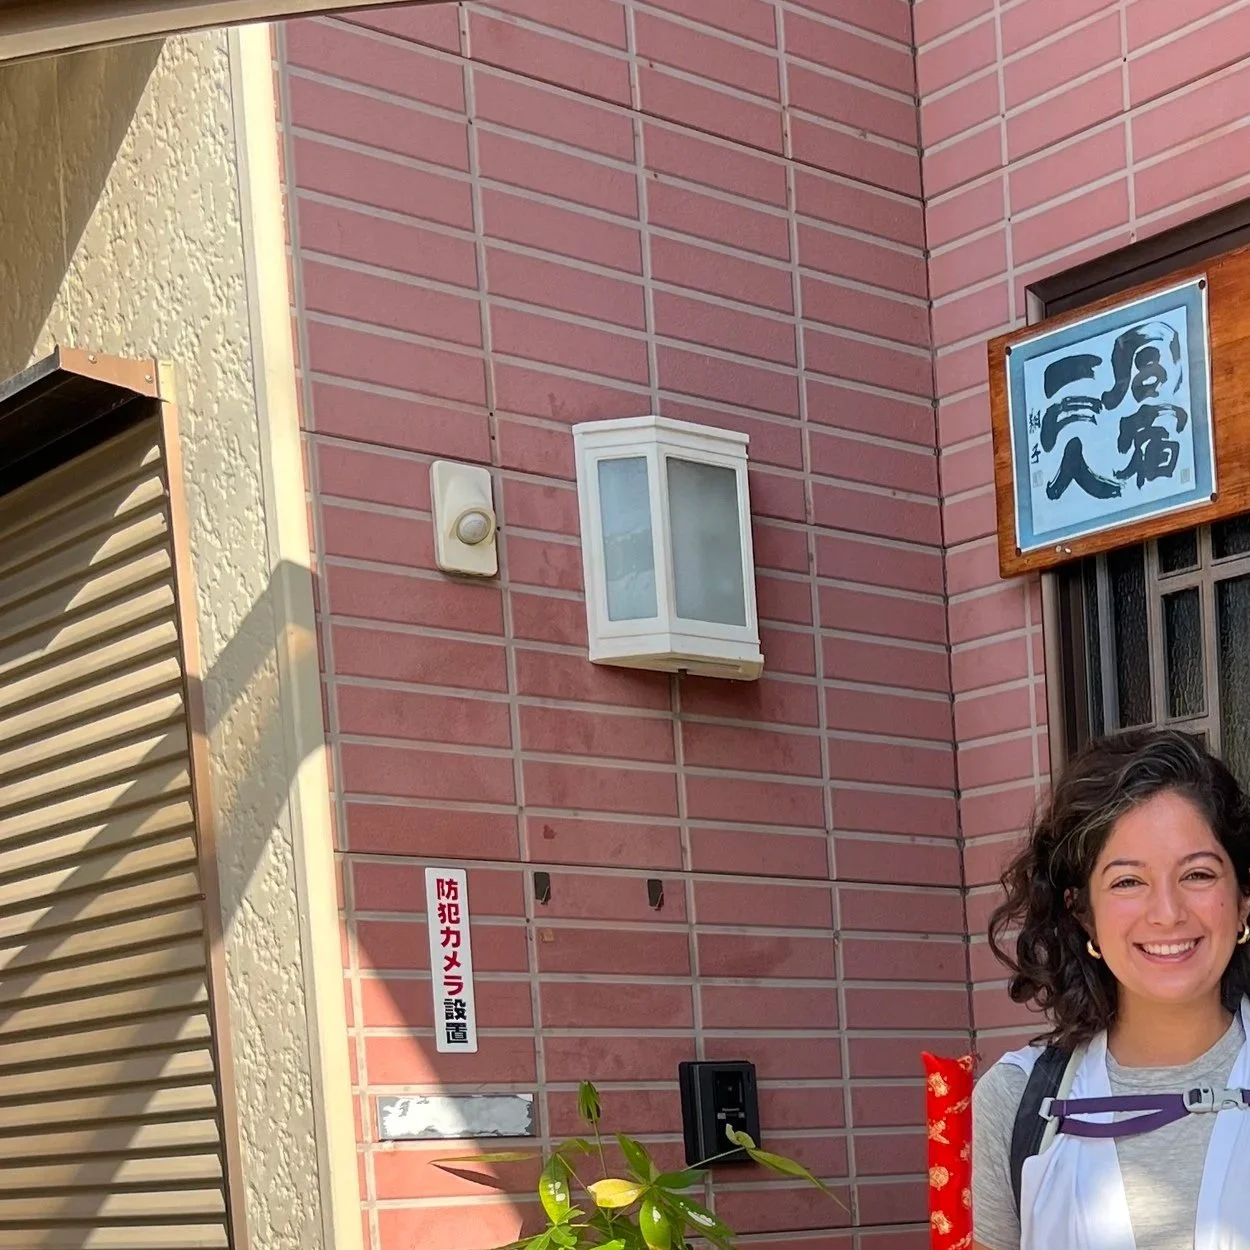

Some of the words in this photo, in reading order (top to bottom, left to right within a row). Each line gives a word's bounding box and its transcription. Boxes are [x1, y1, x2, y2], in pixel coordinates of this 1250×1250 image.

[436, 878, 469, 1044] 防犯カメラ設置
